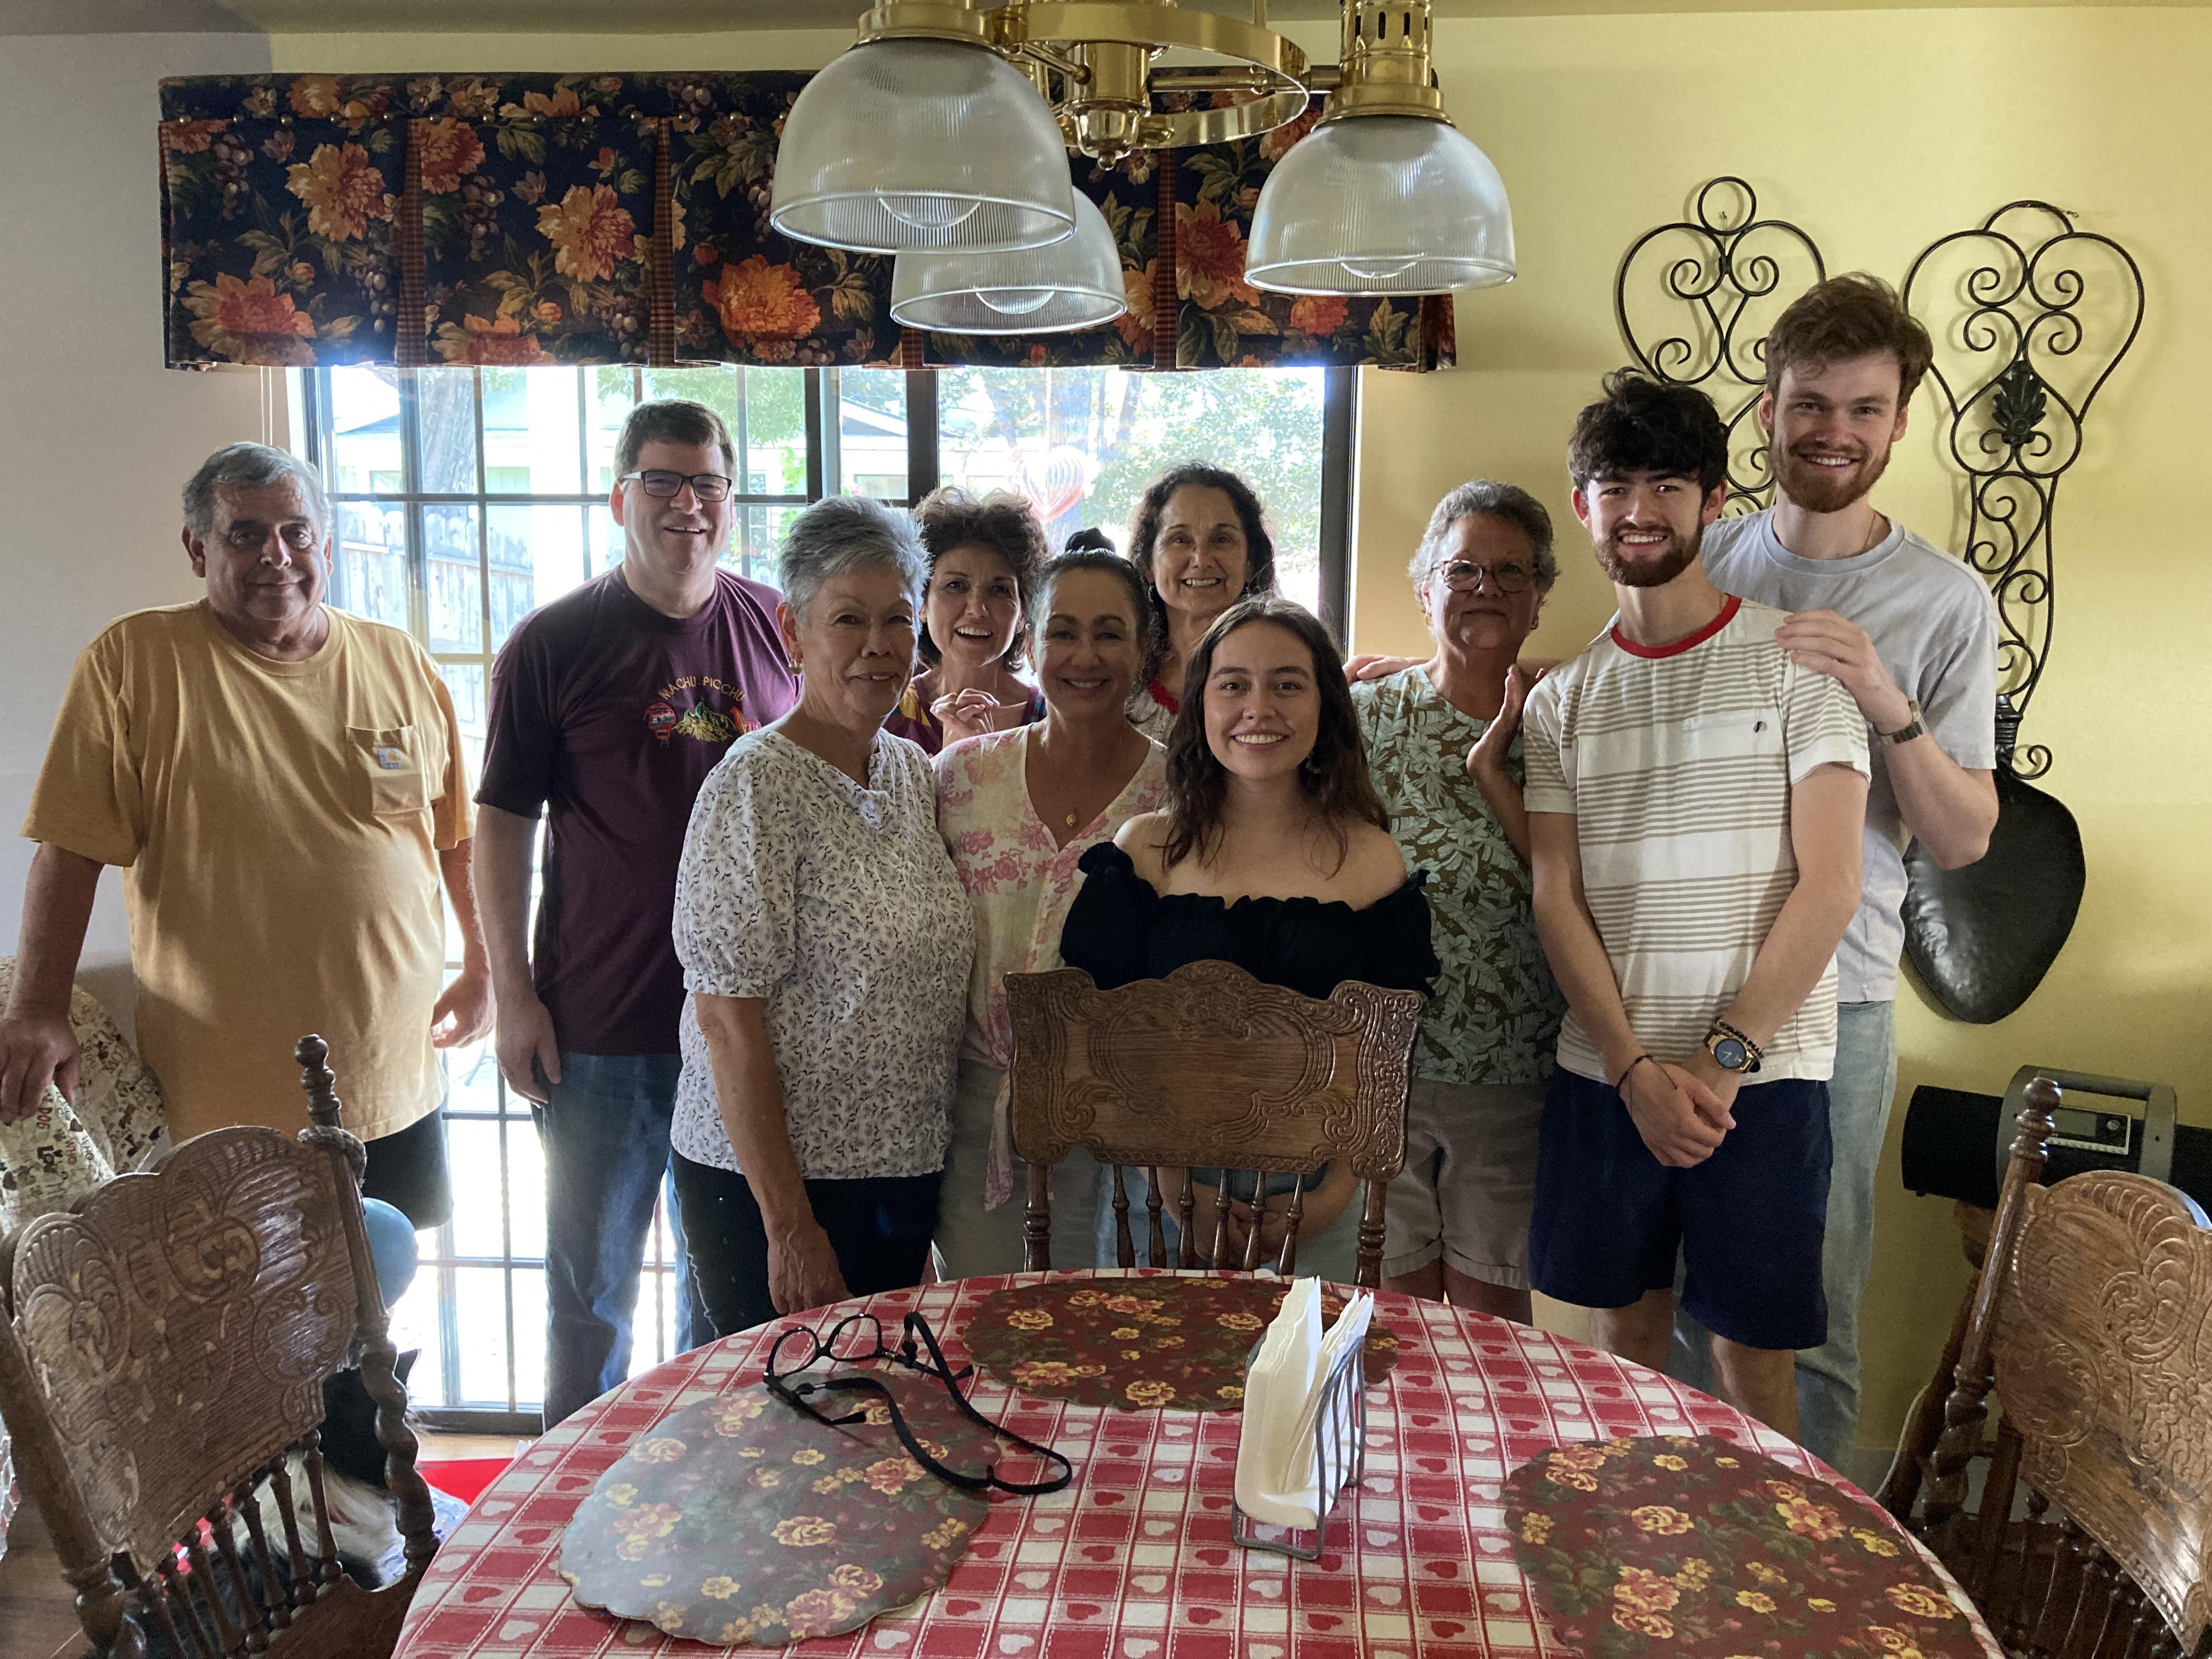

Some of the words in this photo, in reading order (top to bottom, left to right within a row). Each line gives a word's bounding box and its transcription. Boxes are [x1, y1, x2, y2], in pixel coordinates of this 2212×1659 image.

[658, 676, 696, 700] MACHU
[703, 676, 746, 701] PICCHU
[36, 1107, 53, 1129] DOG
[65, 1140, 77, 1165] WHO
[82, 1136, 94, 1161] WHO
